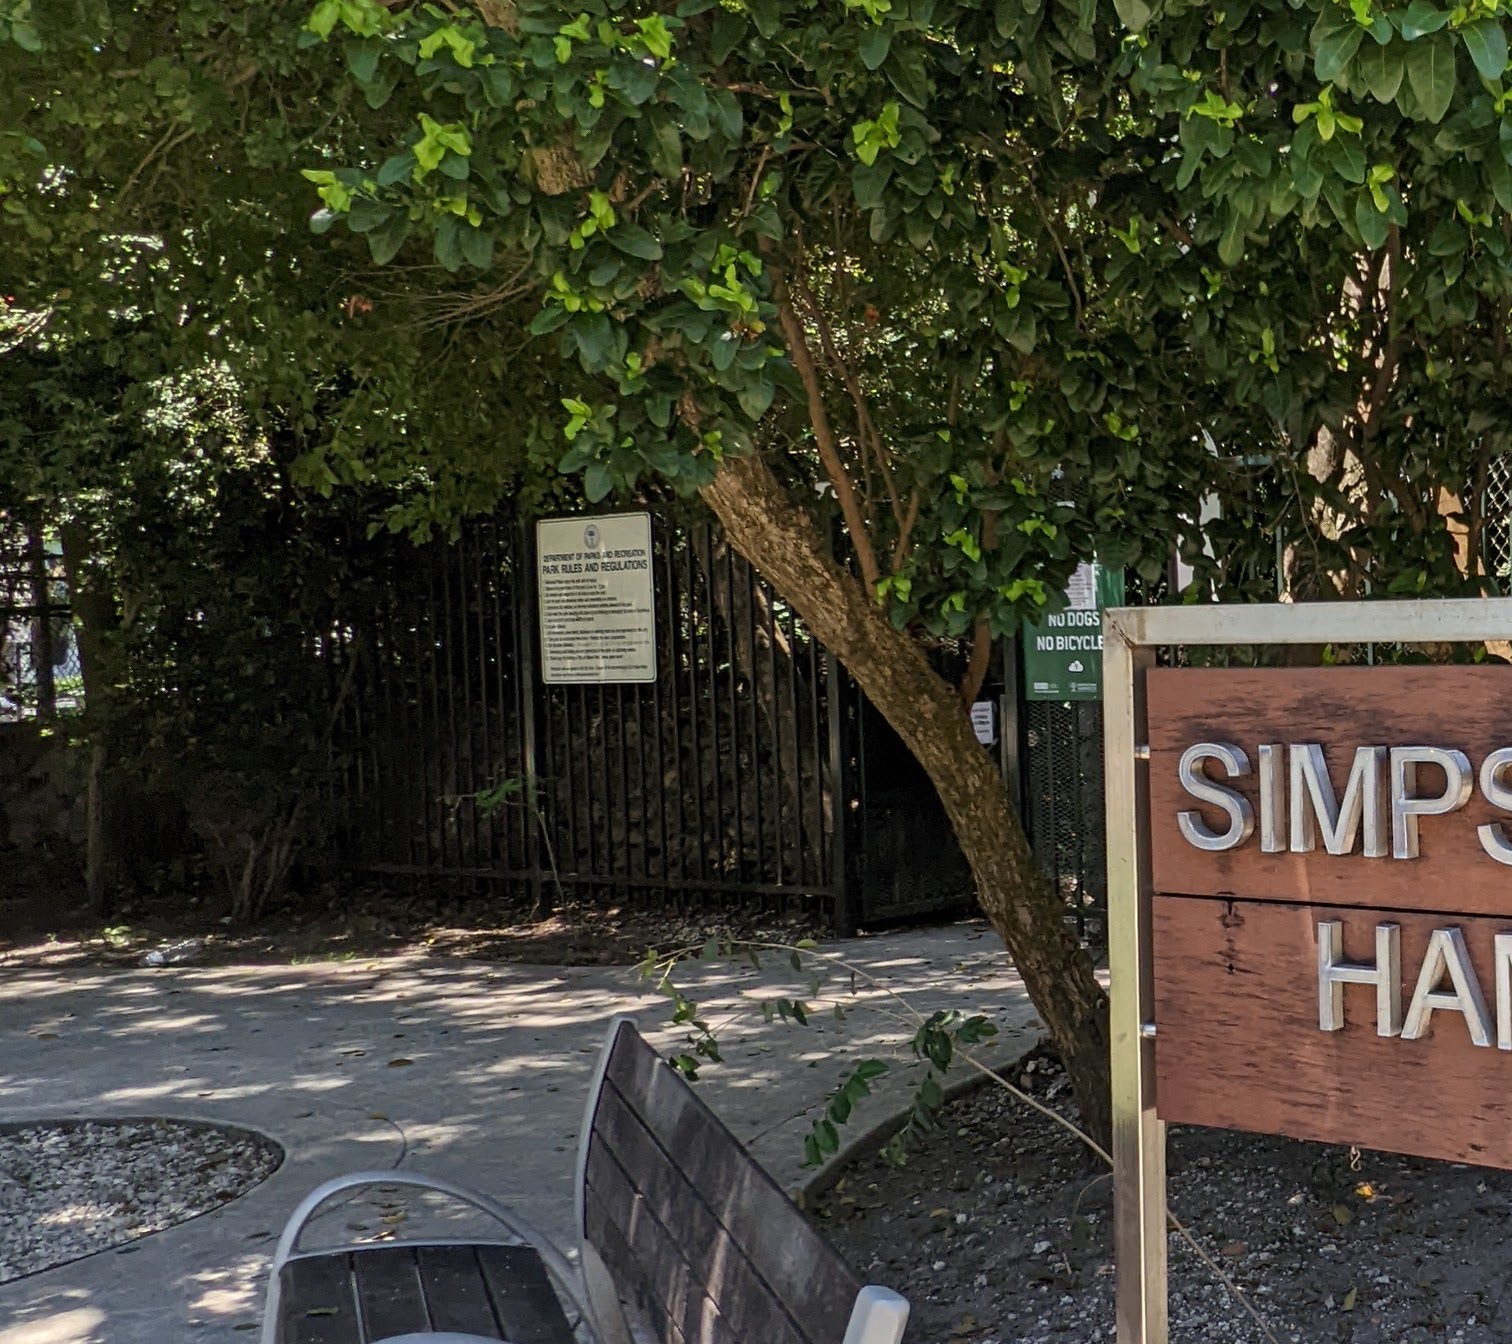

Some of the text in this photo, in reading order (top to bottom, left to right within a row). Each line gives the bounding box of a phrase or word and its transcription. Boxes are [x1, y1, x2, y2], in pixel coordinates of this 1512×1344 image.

[543, 559, 647, 574] PARK RULES AND REGULATIONS
[1048, 611, 1100, 627] NO DOGS
[1037, 635, 1104, 651] NO BICYCLE
